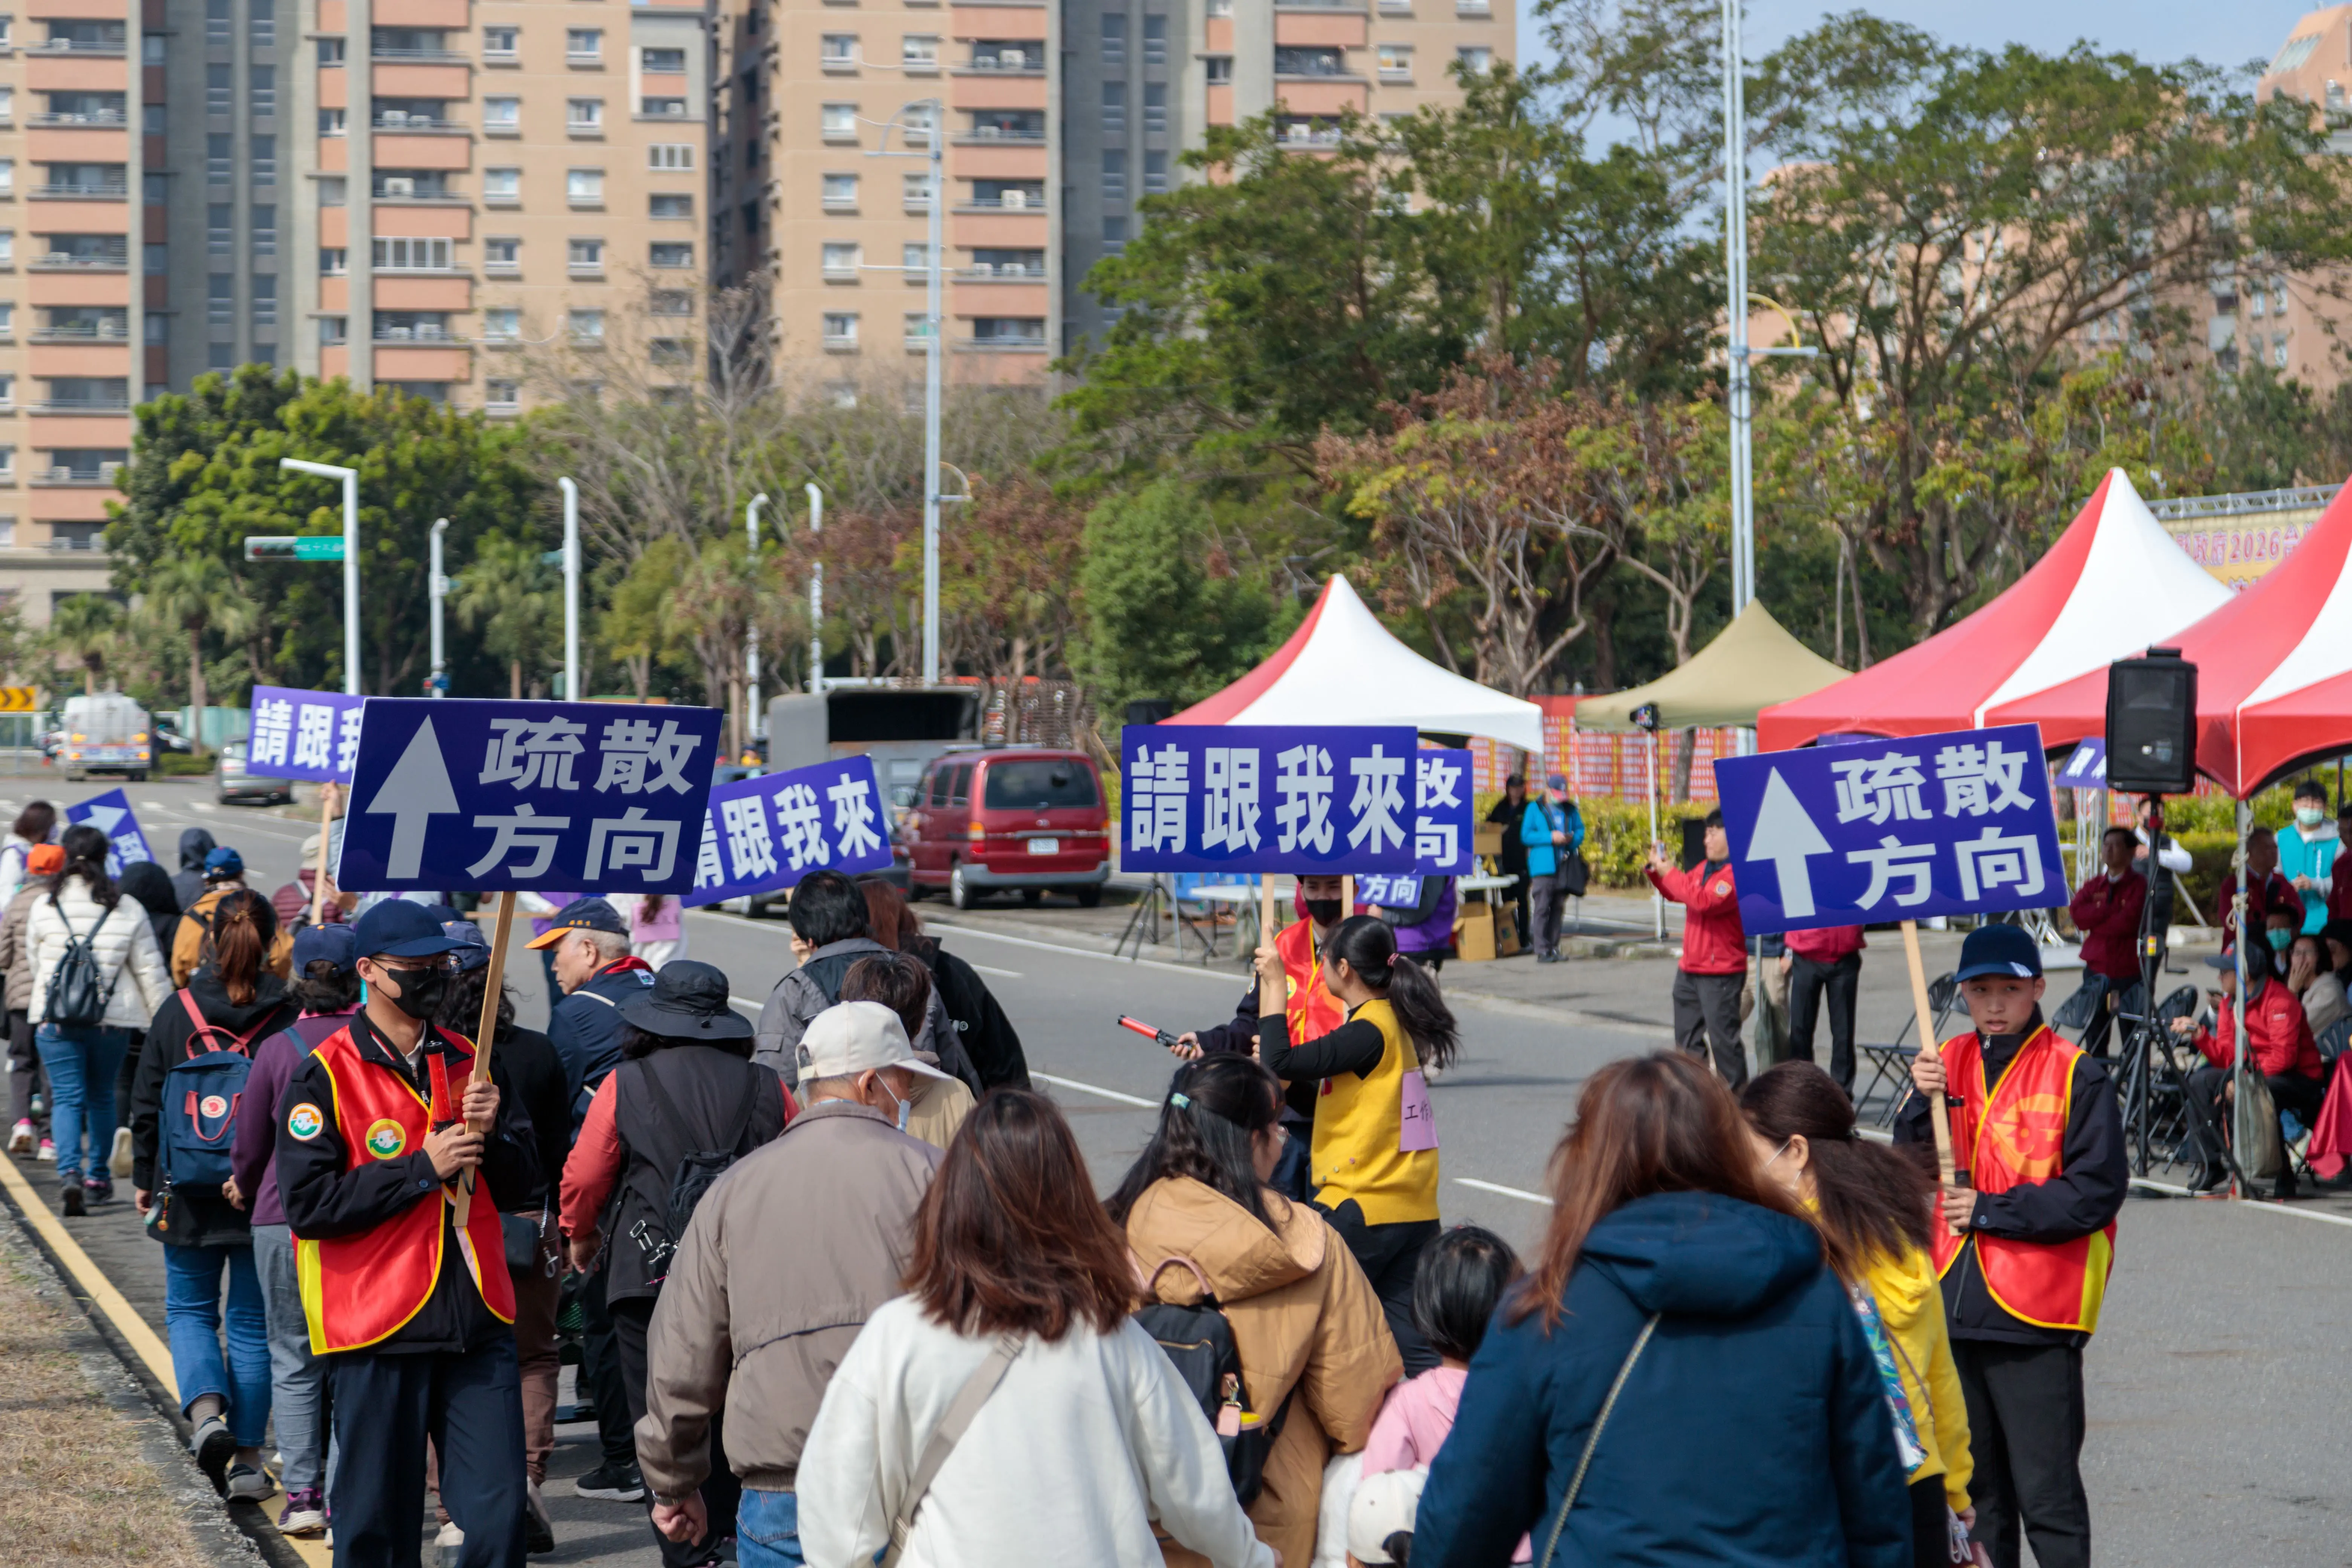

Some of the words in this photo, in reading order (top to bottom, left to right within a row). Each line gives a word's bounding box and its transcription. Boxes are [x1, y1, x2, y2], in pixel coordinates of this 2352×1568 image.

[479, 715, 701, 795] 疏散
[1830, 741, 2035, 825] 疏散
[1131, 743, 1406, 854] 請跟我來
[465, 803, 681, 882] 方向
[1847, 827, 2046, 911] 方向
[1361, 874, 1417, 904] 方向
[1404, 1098, 1432, 1122] 工作
